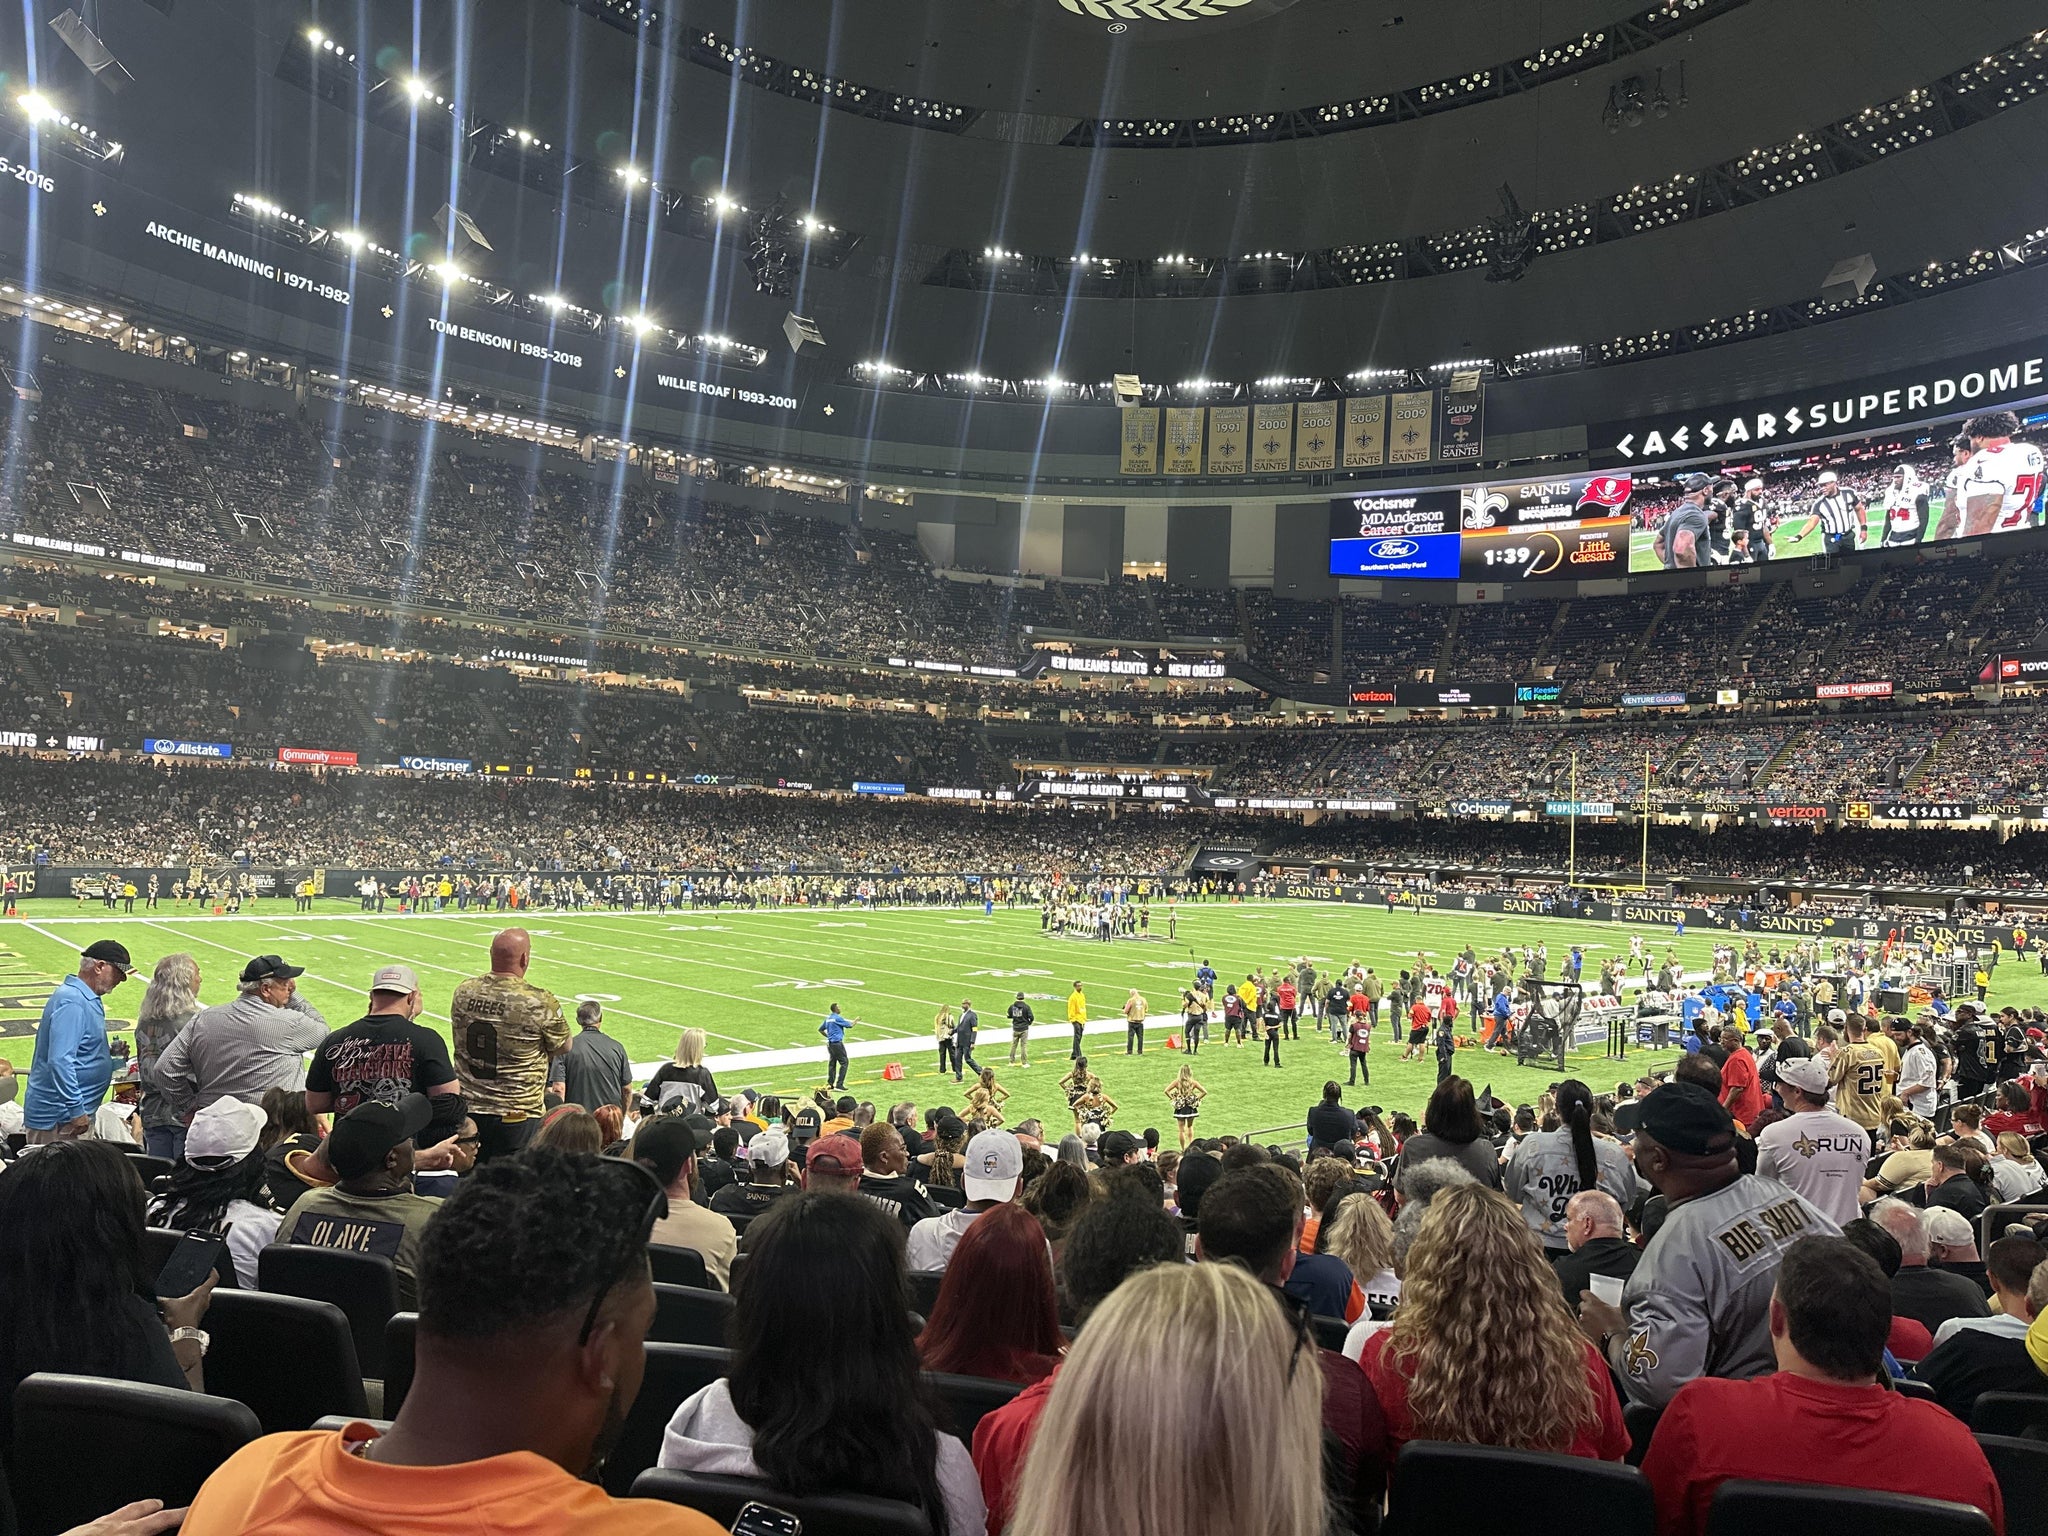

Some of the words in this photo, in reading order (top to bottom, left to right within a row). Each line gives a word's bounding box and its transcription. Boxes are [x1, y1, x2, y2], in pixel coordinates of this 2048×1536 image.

[146, 221, 202, 253] ARCHIE
[203, 242, 274, 279] MANNING
[283, 271, 350, 305] 1971-1982
[428, 318, 457, 337] TOM
[460, 326, 512, 351] BENSON
[519, 342, 582, 368] 1985-2018
[658, 374, 697, 394] WILLIE
[699, 381, 731, 399] ROAF
[737, 389, 797, 409] 1993-2001
[1397, 409, 1426, 419] 2009
[1447, 404, 1477, 414] 2009
[1617, 406, 1804, 458] CAESARS
[1809, 358, 2044, 428] SUPERDOME
[1303, 419, 1331, 428] 2006
[1350, 413, 1380, 424] 2009
[1216, 423, 1240, 433] 1991
[1258, 420, 1287, 430] 2000
[1916, 436, 1931, 445] COX
[1391, 451, 1427, 462] SAINTS
[1442, 447, 1478, 457] SAINTS
[1254, 462, 1287, 471] SAINTS
[1298, 460, 1332, 469] SAINTS
[1346, 456, 1380, 465] SAINTS
[1210, 465, 1243, 473] SAINTS
[1520, 483, 1570, 498] SAINTS
[1361, 498, 1416, 511] Ochsner
[1361, 513, 1383, 525] MD
[1384, 511, 1443, 524] Anderson
[1359, 525, 1404, 536] Cancer
[1404, 522, 1444, 533] Center
[13, 533, 34, 545] NEW
[34, 536, 72, 552] ORLEANS
[73, 543, 105, 557] SAINTS
[1378, 542, 1409, 556] Ford
[1579, 540, 1610, 552] Little
[121, 551, 140, 562] NEW
[141, 554, 176, 568] ORLEANS
[177, 560, 206, 573] SAINTS
[1484, 547, 1530, 565] 1:39
[1570, 551, 1616, 563] Caesars
[1389, 563, 1412, 571] Quality
[226, 568, 266, 582] SAINTS
[312, 582, 349, 594] SAINTS
[48, 593, 90, 606] SAINTS
[390, 592, 425, 605] SAINTS
[141, 605, 180, 618] SAINTS
[466, 604, 499, 615] SAINTS
[230, 617, 267, 628] SAINTS
[537, 614, 569, 625] SAINTS
[312, 627, 346, 638] SAINTS
[606, 624, 636, 634] SAINTS
[670, 632, 699, 641] SAINTS
[732, 640, 759, 649] SAINTS
[491, 648, 536, 661] CAESARS
[536, 654, 588, 666] SUPERDOME
[1067, 658, 1110, 673] ORLEANS
[1111, 660, 1148, 675] SAINTS
[1168, 664, 1191, 676] NEW
[1818, 684, 1849, 696] ROUSES
[1851, 682, 1890, 694] MARKETS
[1904, 679, 1941, 690] SAINTS
[1353, 691, 1393, 702] verizon
[1748, 686, 1781, 697] SAINTS
[1583, 696, 1613, 704] SAINTS
[1622, 696, 1655, 704] VENTURE
[1656, 695, 1684, 703] GLOBAL
[67, 736, 98, 751] NEW
[235, 746, 274, 757] SAINTS
[283, 749, 330, 763] Community
[412, 757, 469, 773] Ochsner
[526, 765, 534, 775] 0
[628, 771, 635, 780] 0
[694, 773, 719, 785] COX
[737, 776, 764, 786] SAINTS
[786, 781, 813, 791] entergy
[1051, 783, 1089, 795] ORLEANS
[1090, 785, 1124, 796] SAINTS
[1142, 786, 1163, 797] NEW
[954, 788, 981, 799] SAINTS
[995, 790, 1013, 800] NEW
[1214, 799, 1236, 808] SAINTS
[1248, 800, 1262, 808] NEW
[1263, 800, 1289, 809] ORLEANS
[1290, 800, 1314, 809] SAINTS
[1327, 801, 1341, 809] NEW
[1342, 801, 1370, 810] ORLEANS
[1371, 801, 1396, 810] SAINTS
[1458, 802, 1510, 814] Ochsner
[1548, 803, 1580, 813] PEOPLES
[1582, 803, 1613, 815] HEALTH
[1705, 803, 1740, 812] SAINTS
[1767, 806, 1827, 818] verizon
[1850, 805, 1868, 818] 25
[1887, 806, 1962, 818] CAESARS
[1977, 805, 2021, 815] SAINTS
[1287, 886, 1331, 899] SAINTS
[1760, 915, 1825, 932] SAINTS
[1914, 925, 1985, 943] SAINTS
[468, 998, 505, 1016] BREES
[466, 1022, 498, 1079] 9
[1857, 1065, 1884, 1095] 25
[1818, 1138, 1862, 1152] RUN
[914, 1179, 928, 1198] 5
[746, 1193, 770, 1201] SAINTS
[311, 1220, 376, 1252] OLAVE
[1719, 1220, 1766, 1262] BIG
[1758, 1198, 1812, 1240] SHOT
